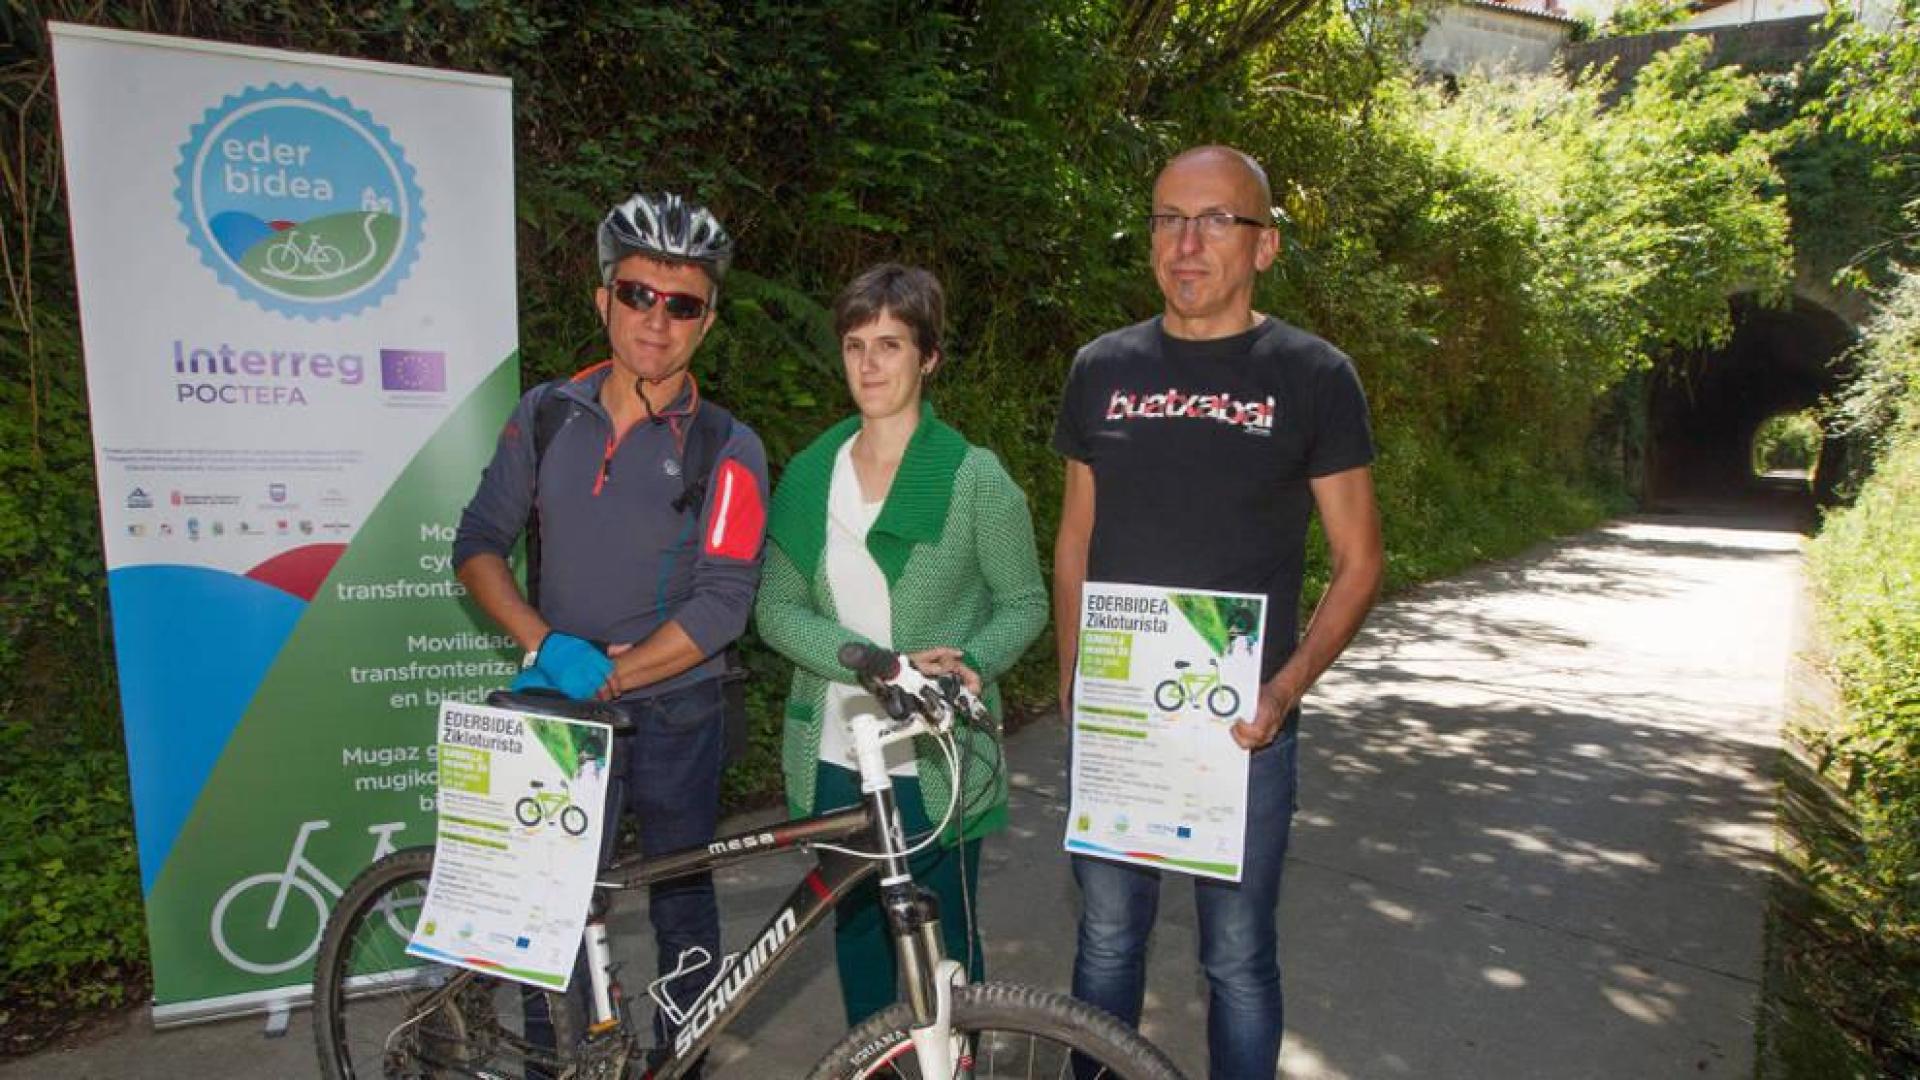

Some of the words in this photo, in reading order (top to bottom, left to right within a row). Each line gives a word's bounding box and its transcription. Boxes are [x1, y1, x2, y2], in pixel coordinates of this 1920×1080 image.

[222, 131, 311, 166] eder
[224, 167, 333, 201] bidea
[173, 340, 364, 384] Interreg
[177, 384, 307, 406] POCTEFA
[420, 523, 457, 542] Mo
[337, 579, 467, 600] transfronta
[1087, 594, 1169, 614] EDERBIDEA
[1086, 612, 1167, 634] Zikloturista
[351, 658, 518, 683] transfronteriza
[390, 693, 418, 708] en
[444, 711, 524, 736] EDERBIDEA
[342, 746, 419, 766] Mugaz
[355, 769, 440, 791] mugiko
[674, 907, 797, 1059] SCHWINN
